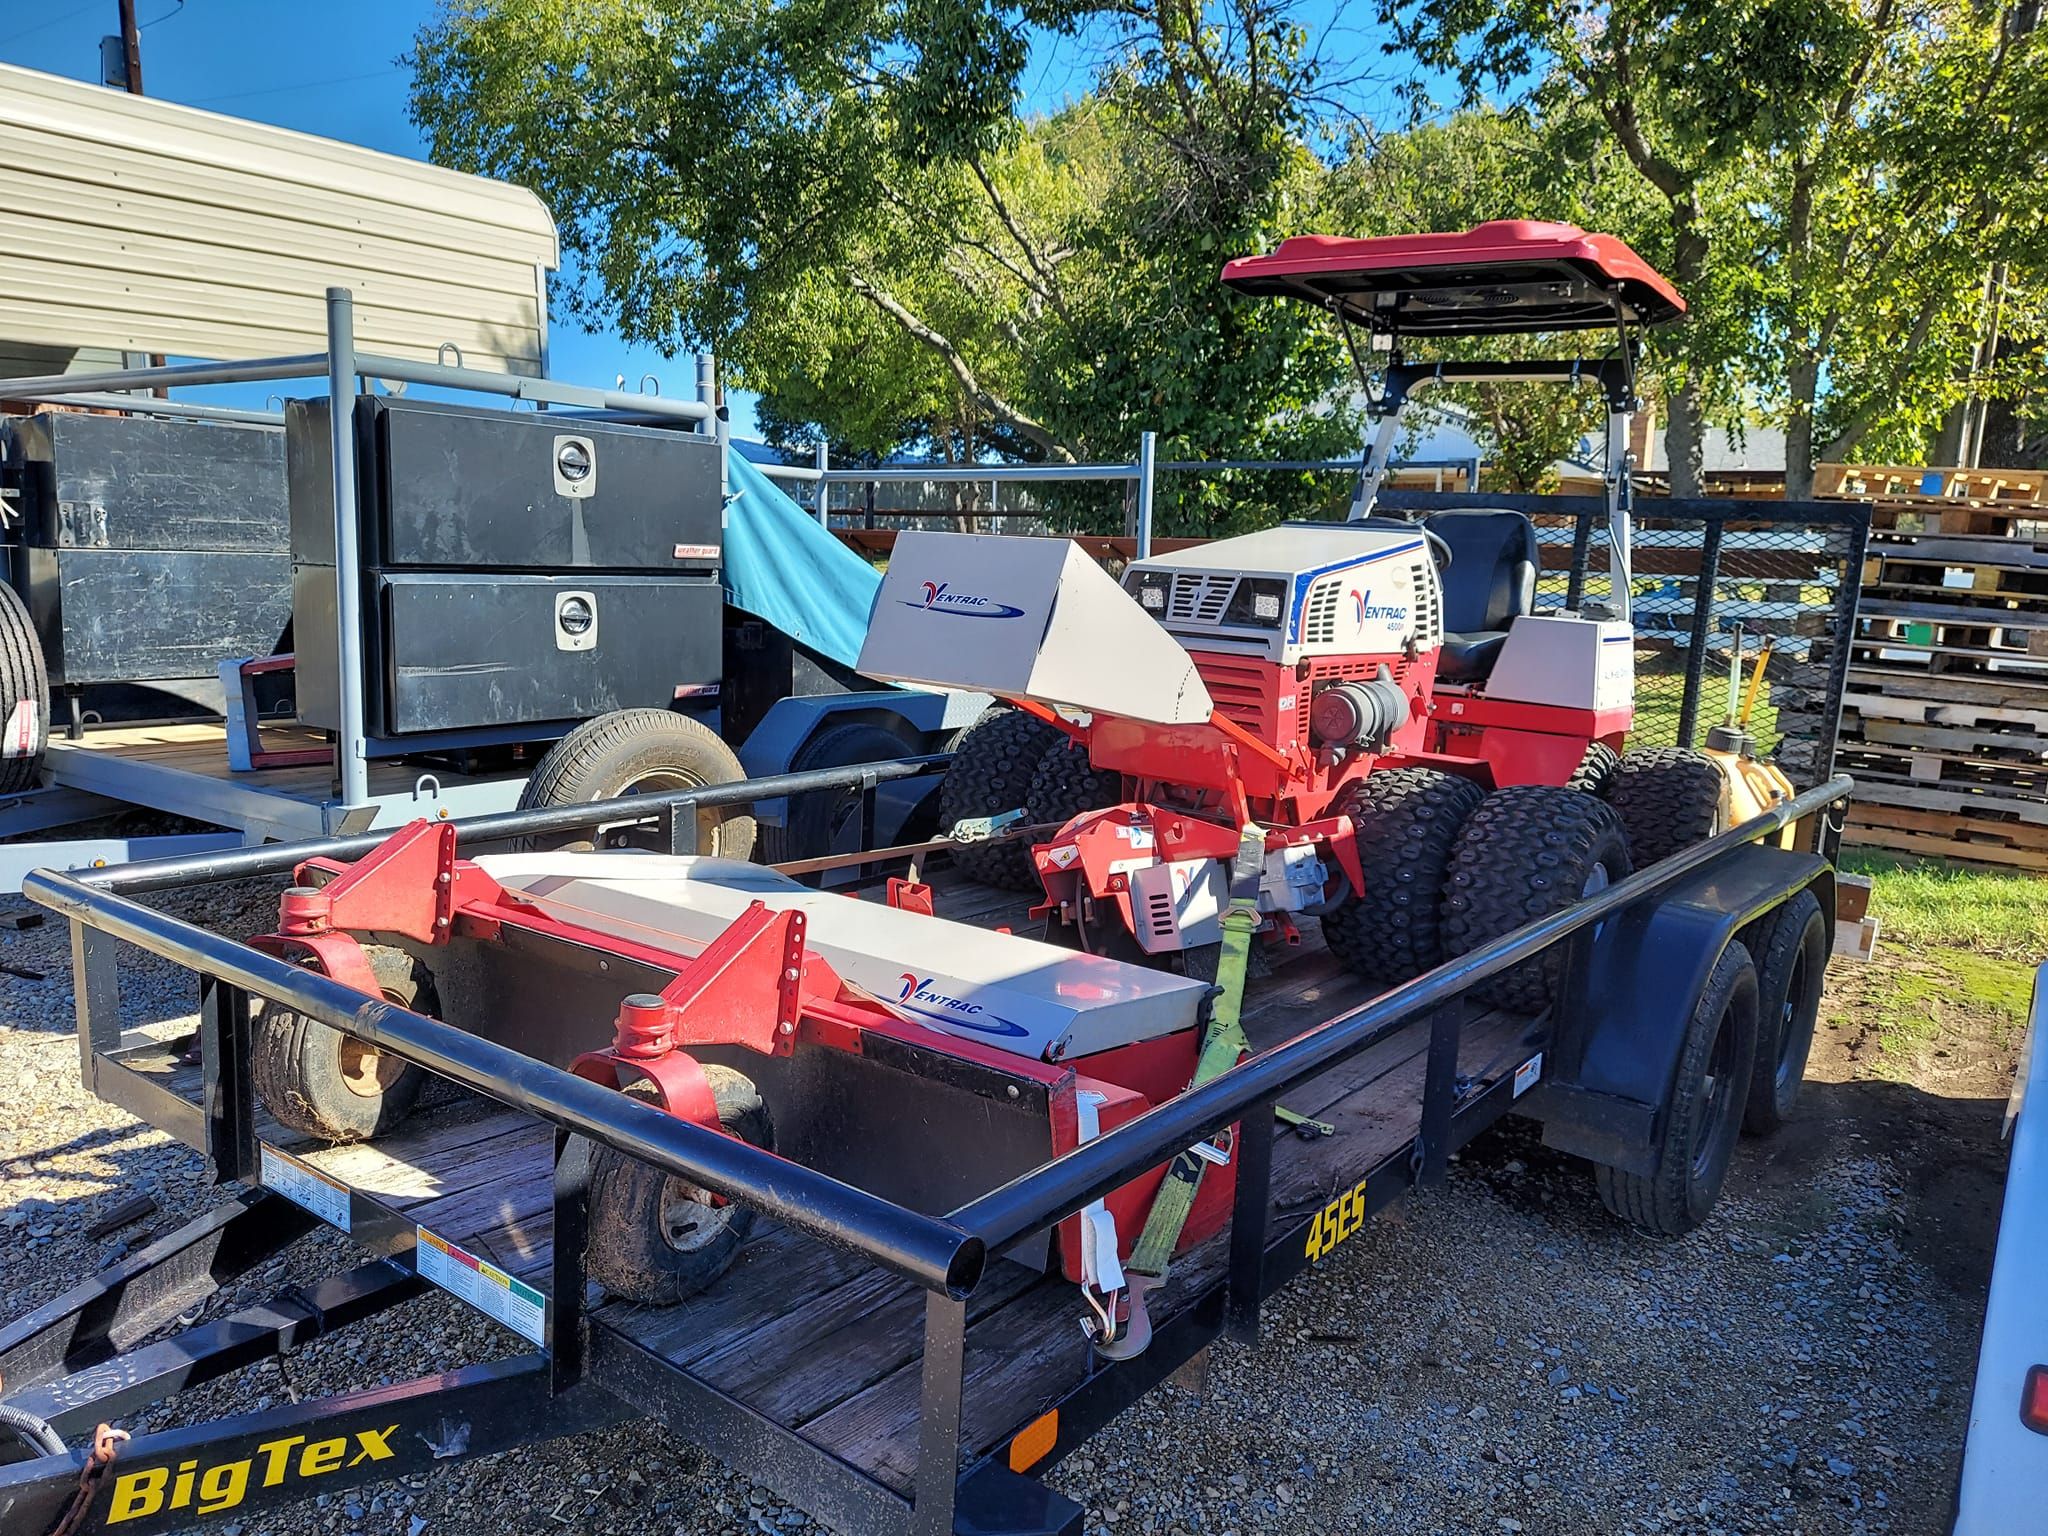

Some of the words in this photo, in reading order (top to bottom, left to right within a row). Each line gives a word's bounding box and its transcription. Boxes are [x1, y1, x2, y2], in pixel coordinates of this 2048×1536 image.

[920, 581, 989, 609] VENTRAC
[1350, 590, 1407, 633] VENTRAC
[899, 973, 983, 1014] VENTRAC
